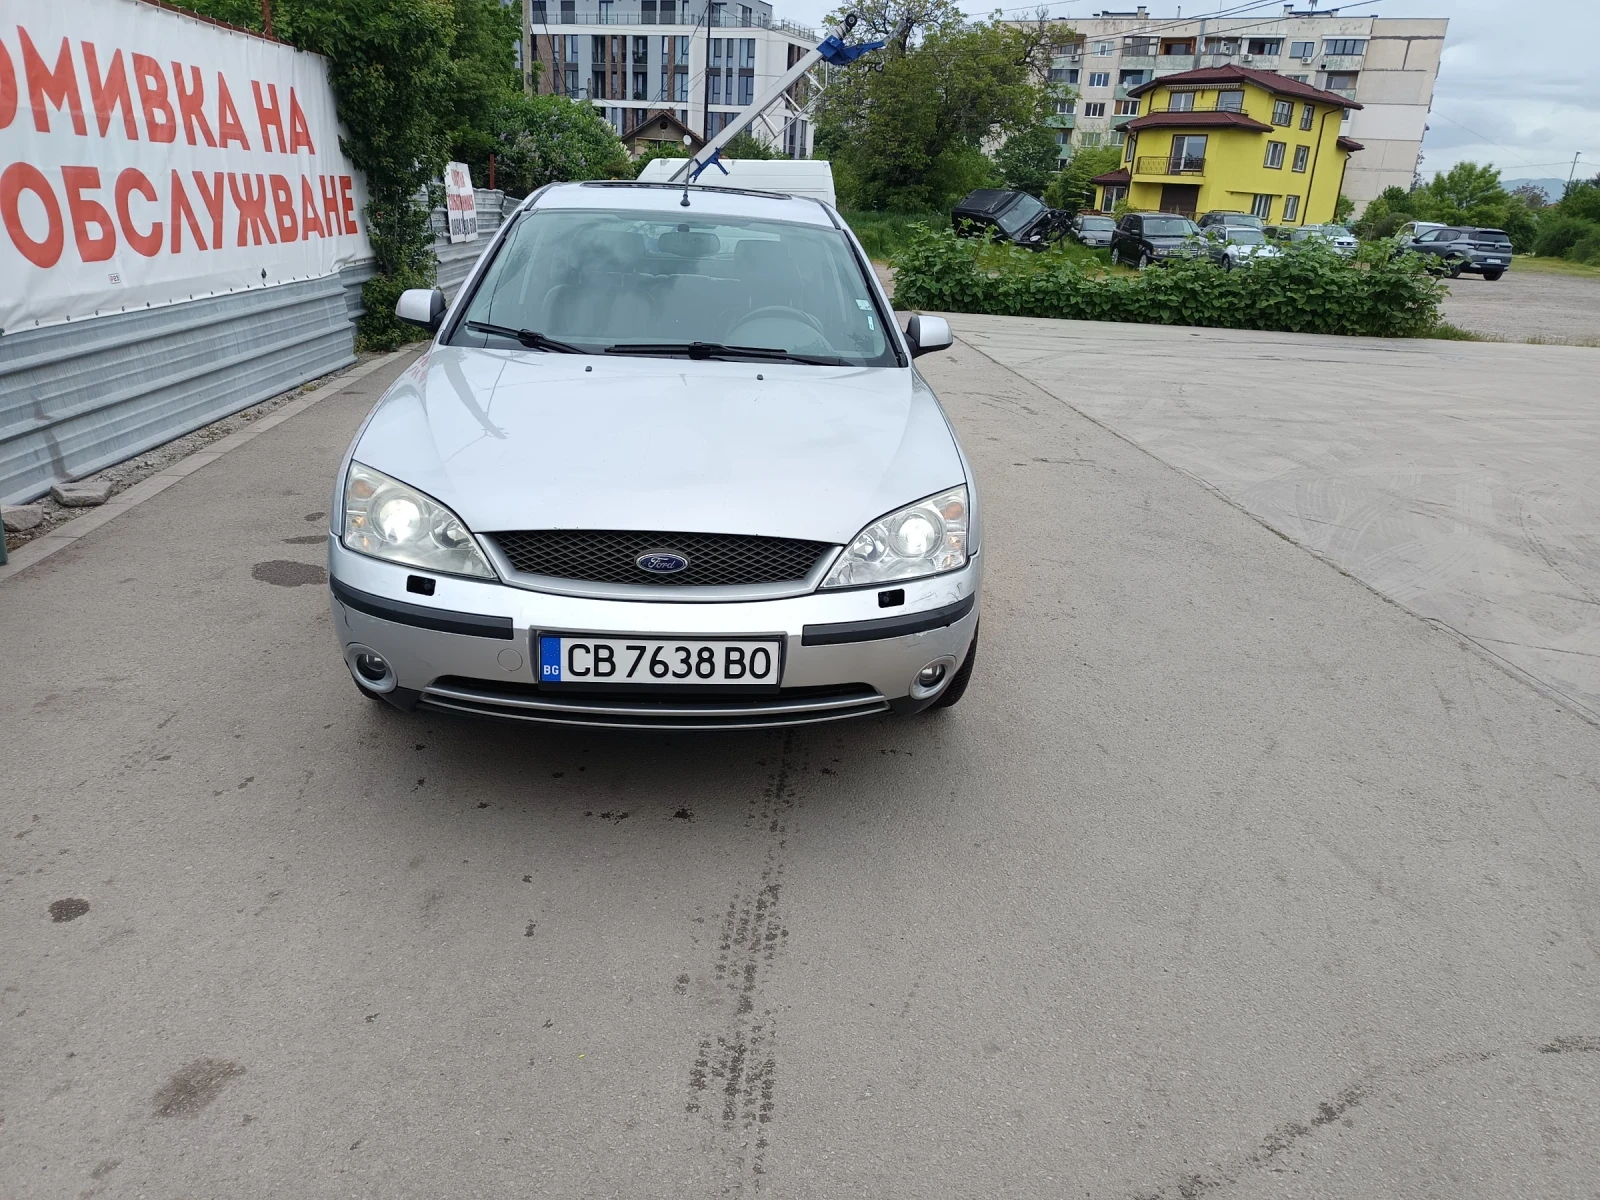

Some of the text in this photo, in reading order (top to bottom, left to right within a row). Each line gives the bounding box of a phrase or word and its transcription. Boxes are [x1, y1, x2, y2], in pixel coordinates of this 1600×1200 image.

[0, 25, 316, 155] МИВКА НА
[0, 161, 358, 269] ОБСЛУЖВАНЕ
[648, 557, 676, 568] Ford
[543, 664, 560, 675] BG
[567, 643, 617, 678] CB
[625, 645, 716, 680] 7638
